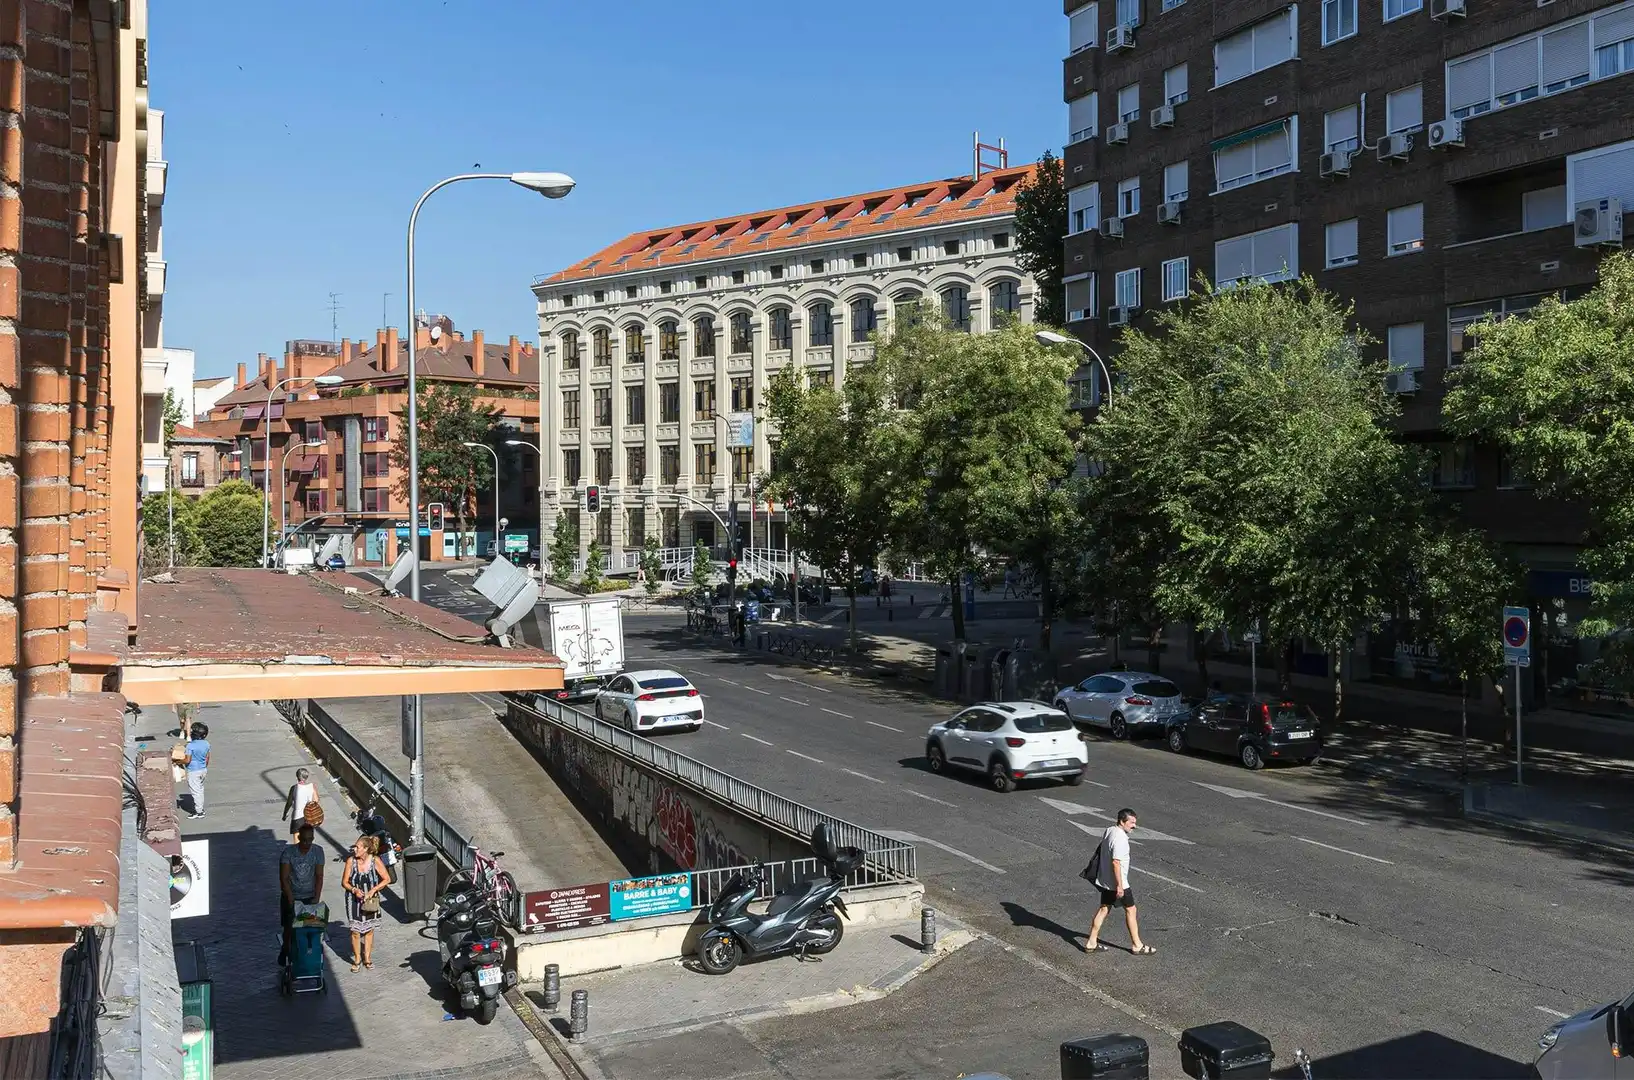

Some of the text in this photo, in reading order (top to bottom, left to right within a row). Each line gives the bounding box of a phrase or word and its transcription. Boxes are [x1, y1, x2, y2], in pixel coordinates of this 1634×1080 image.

[623, 890, 650, 900] BARRE
[651, 889, 657, 897] &
[657, 886, 678, 896] BABY
